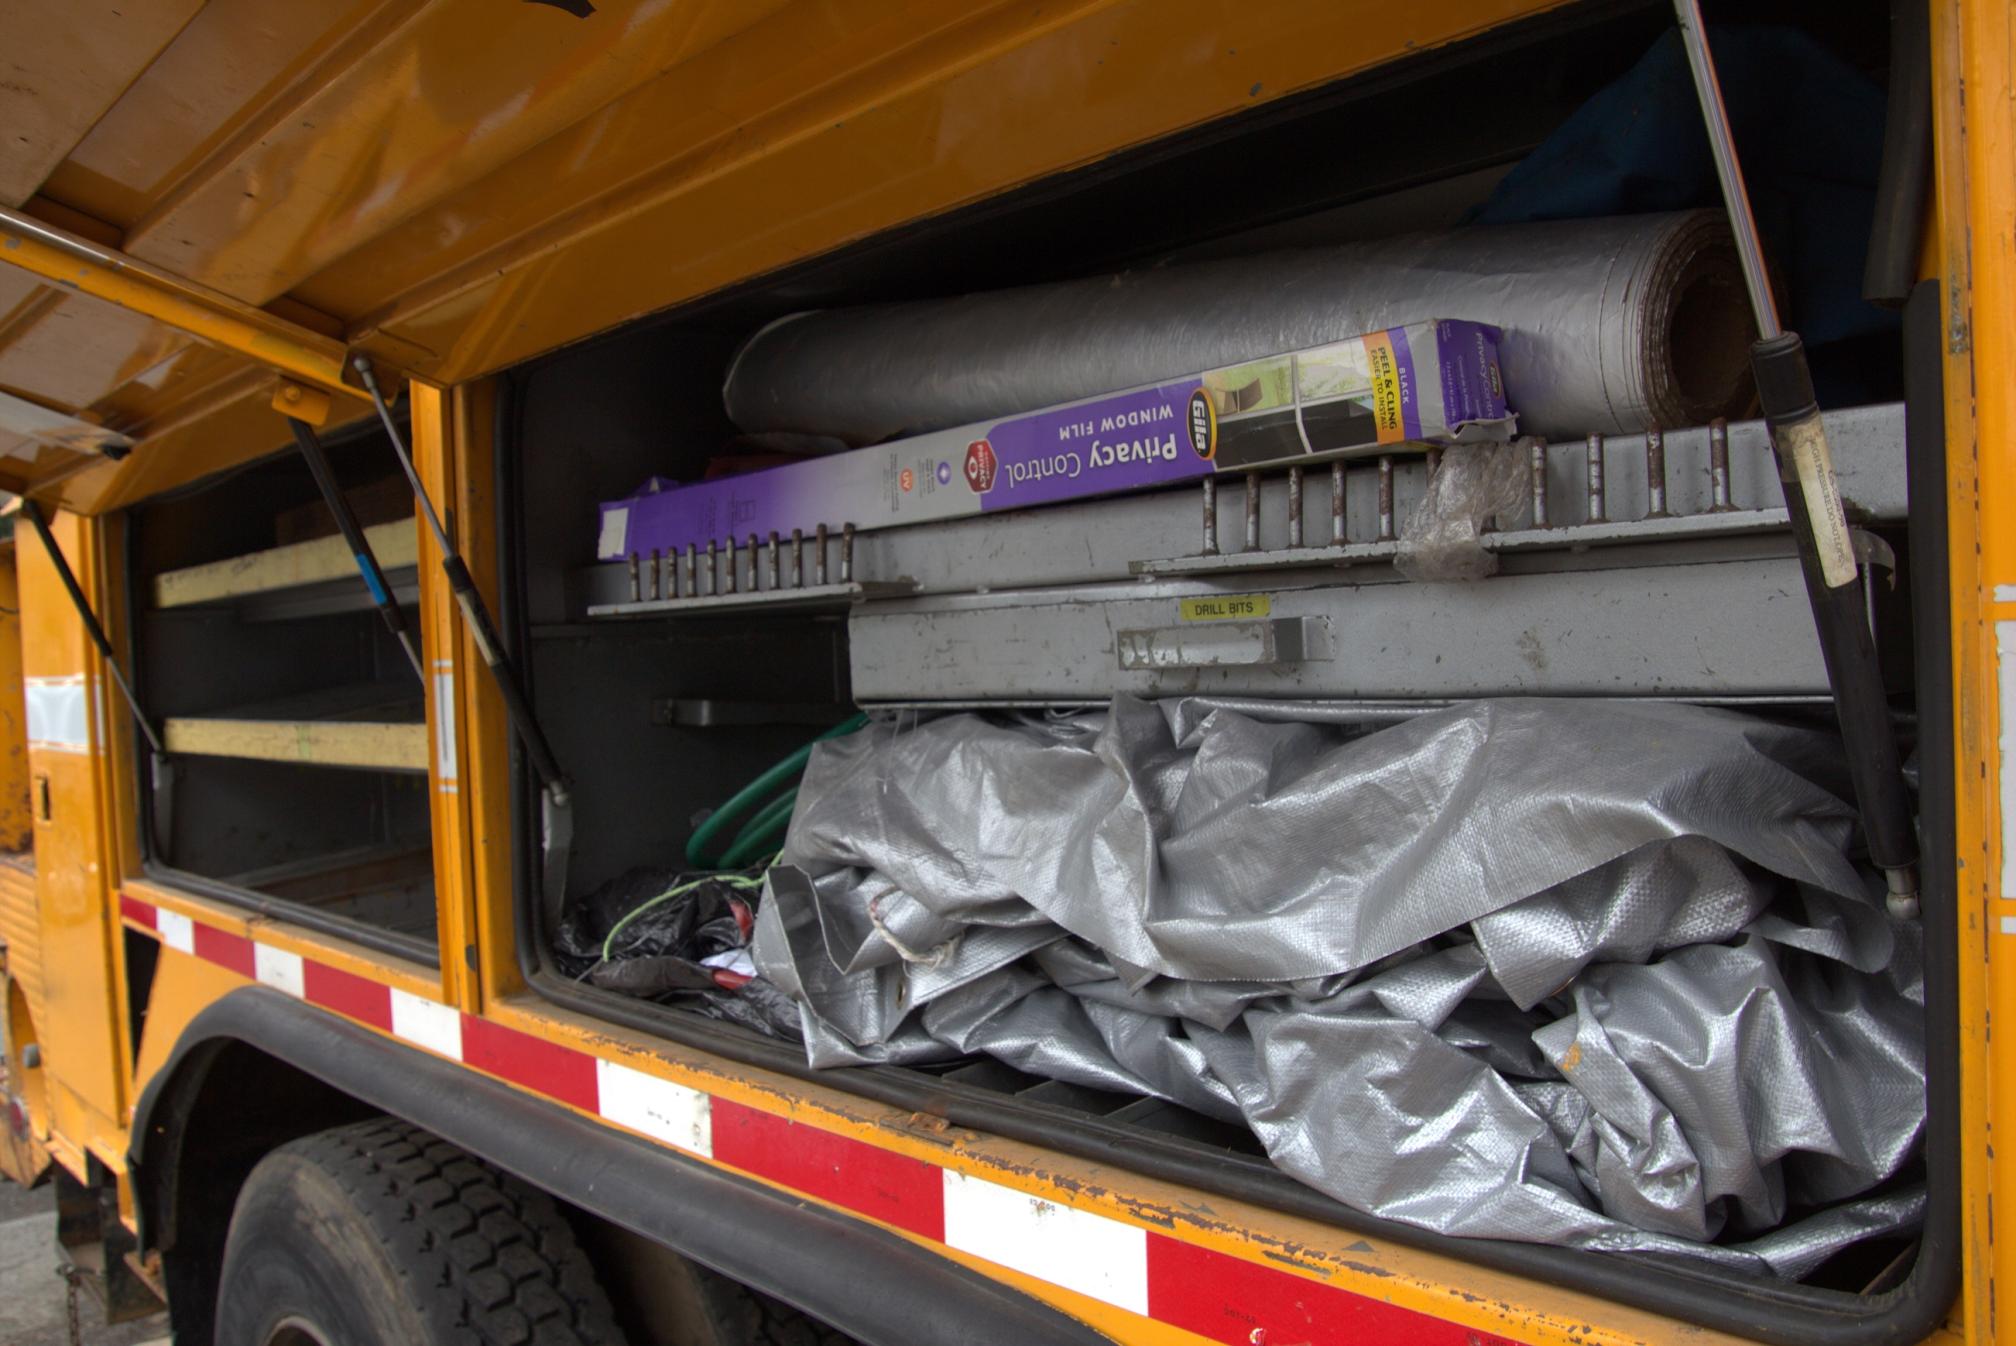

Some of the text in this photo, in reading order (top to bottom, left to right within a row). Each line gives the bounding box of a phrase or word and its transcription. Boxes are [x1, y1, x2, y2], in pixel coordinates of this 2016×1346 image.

[1476, 333, 1488, 377] Privacy
[1371, 350, 1386, 430] EASIER TO INSTALL
[1378, 347, 1398, 430] PEEL & CLING
[1399, 367, 1410, 404] BLACK
[1059, 404, 1173, 440] WINDOW FILM
[1192, 400, 1207, 450] Gila
[977, 444, 987, 489] PRIVACY
[1089, 433, 1178, 468] Privacy
[902, 471, 909, 489] UV
[1005, 452, 1081, 488] Control
[1816, 463, 1831, 506] PRESSURE
[1827, 506, 1836, 521] DO
[1831, 521, 1841, 542] NOT
[1195, 602, 1254, 616] DRILL BITS
